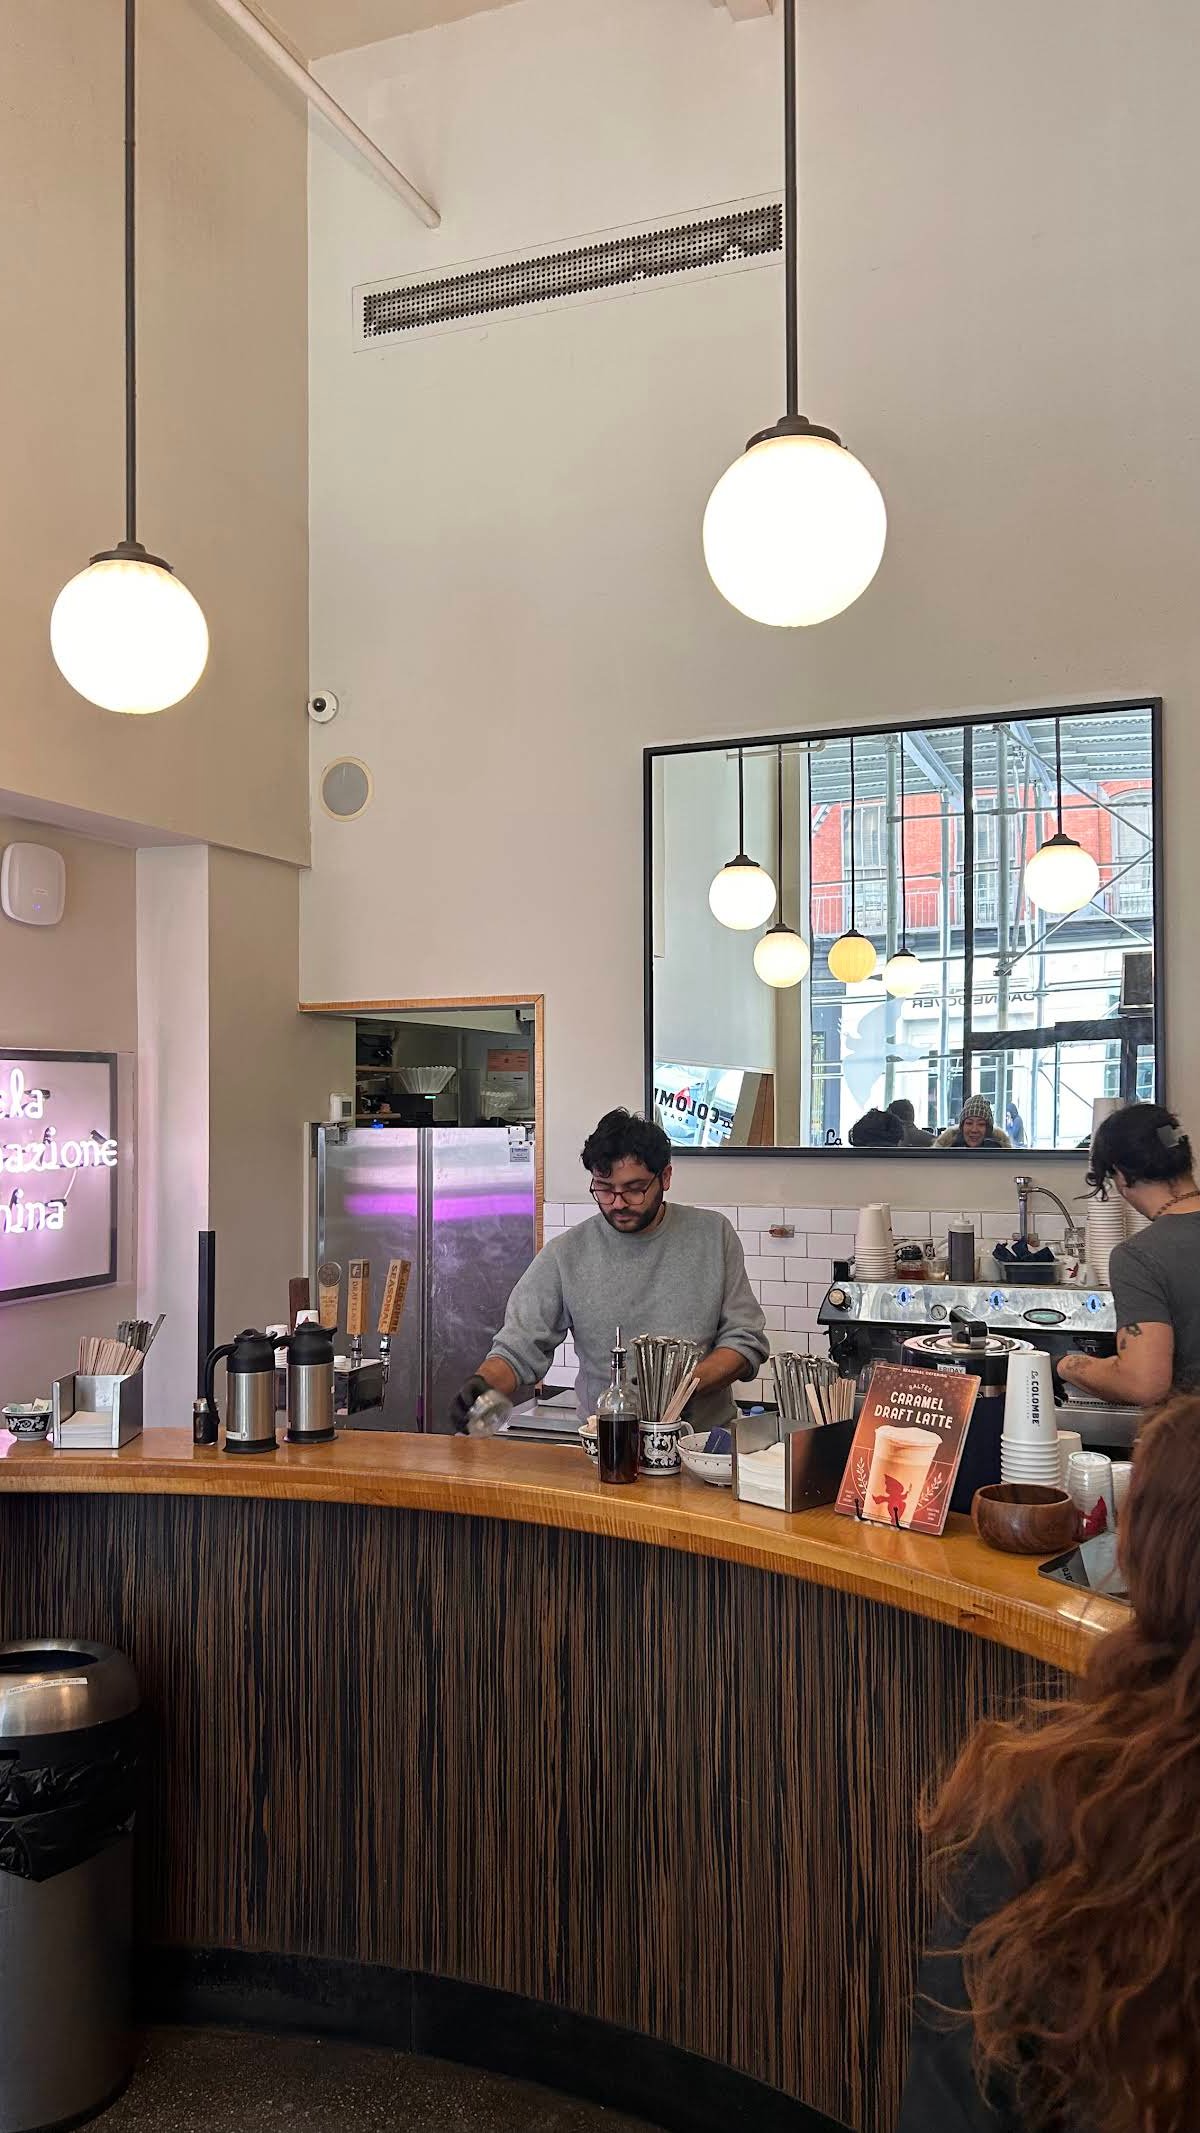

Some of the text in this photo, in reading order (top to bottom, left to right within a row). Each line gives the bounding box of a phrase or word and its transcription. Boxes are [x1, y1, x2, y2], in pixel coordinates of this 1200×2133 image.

[825, 1129, 843, 1146] La
[0, 1126, 118, 1173] azione
[380, 1264, 398, 1329] SEASONAL
[902, 1368, 924, 1376] SEASONAL
[938, 1365, 965, 1375] FRIDAY
[908, 1383, 933, 1394] SALTED
[890, 1391, 944, 1412] CARAMEL
[1031, 1380, 1040, 1425] COLOMBE
[874, 1404, 953, 1429] DRAFT LATTE
